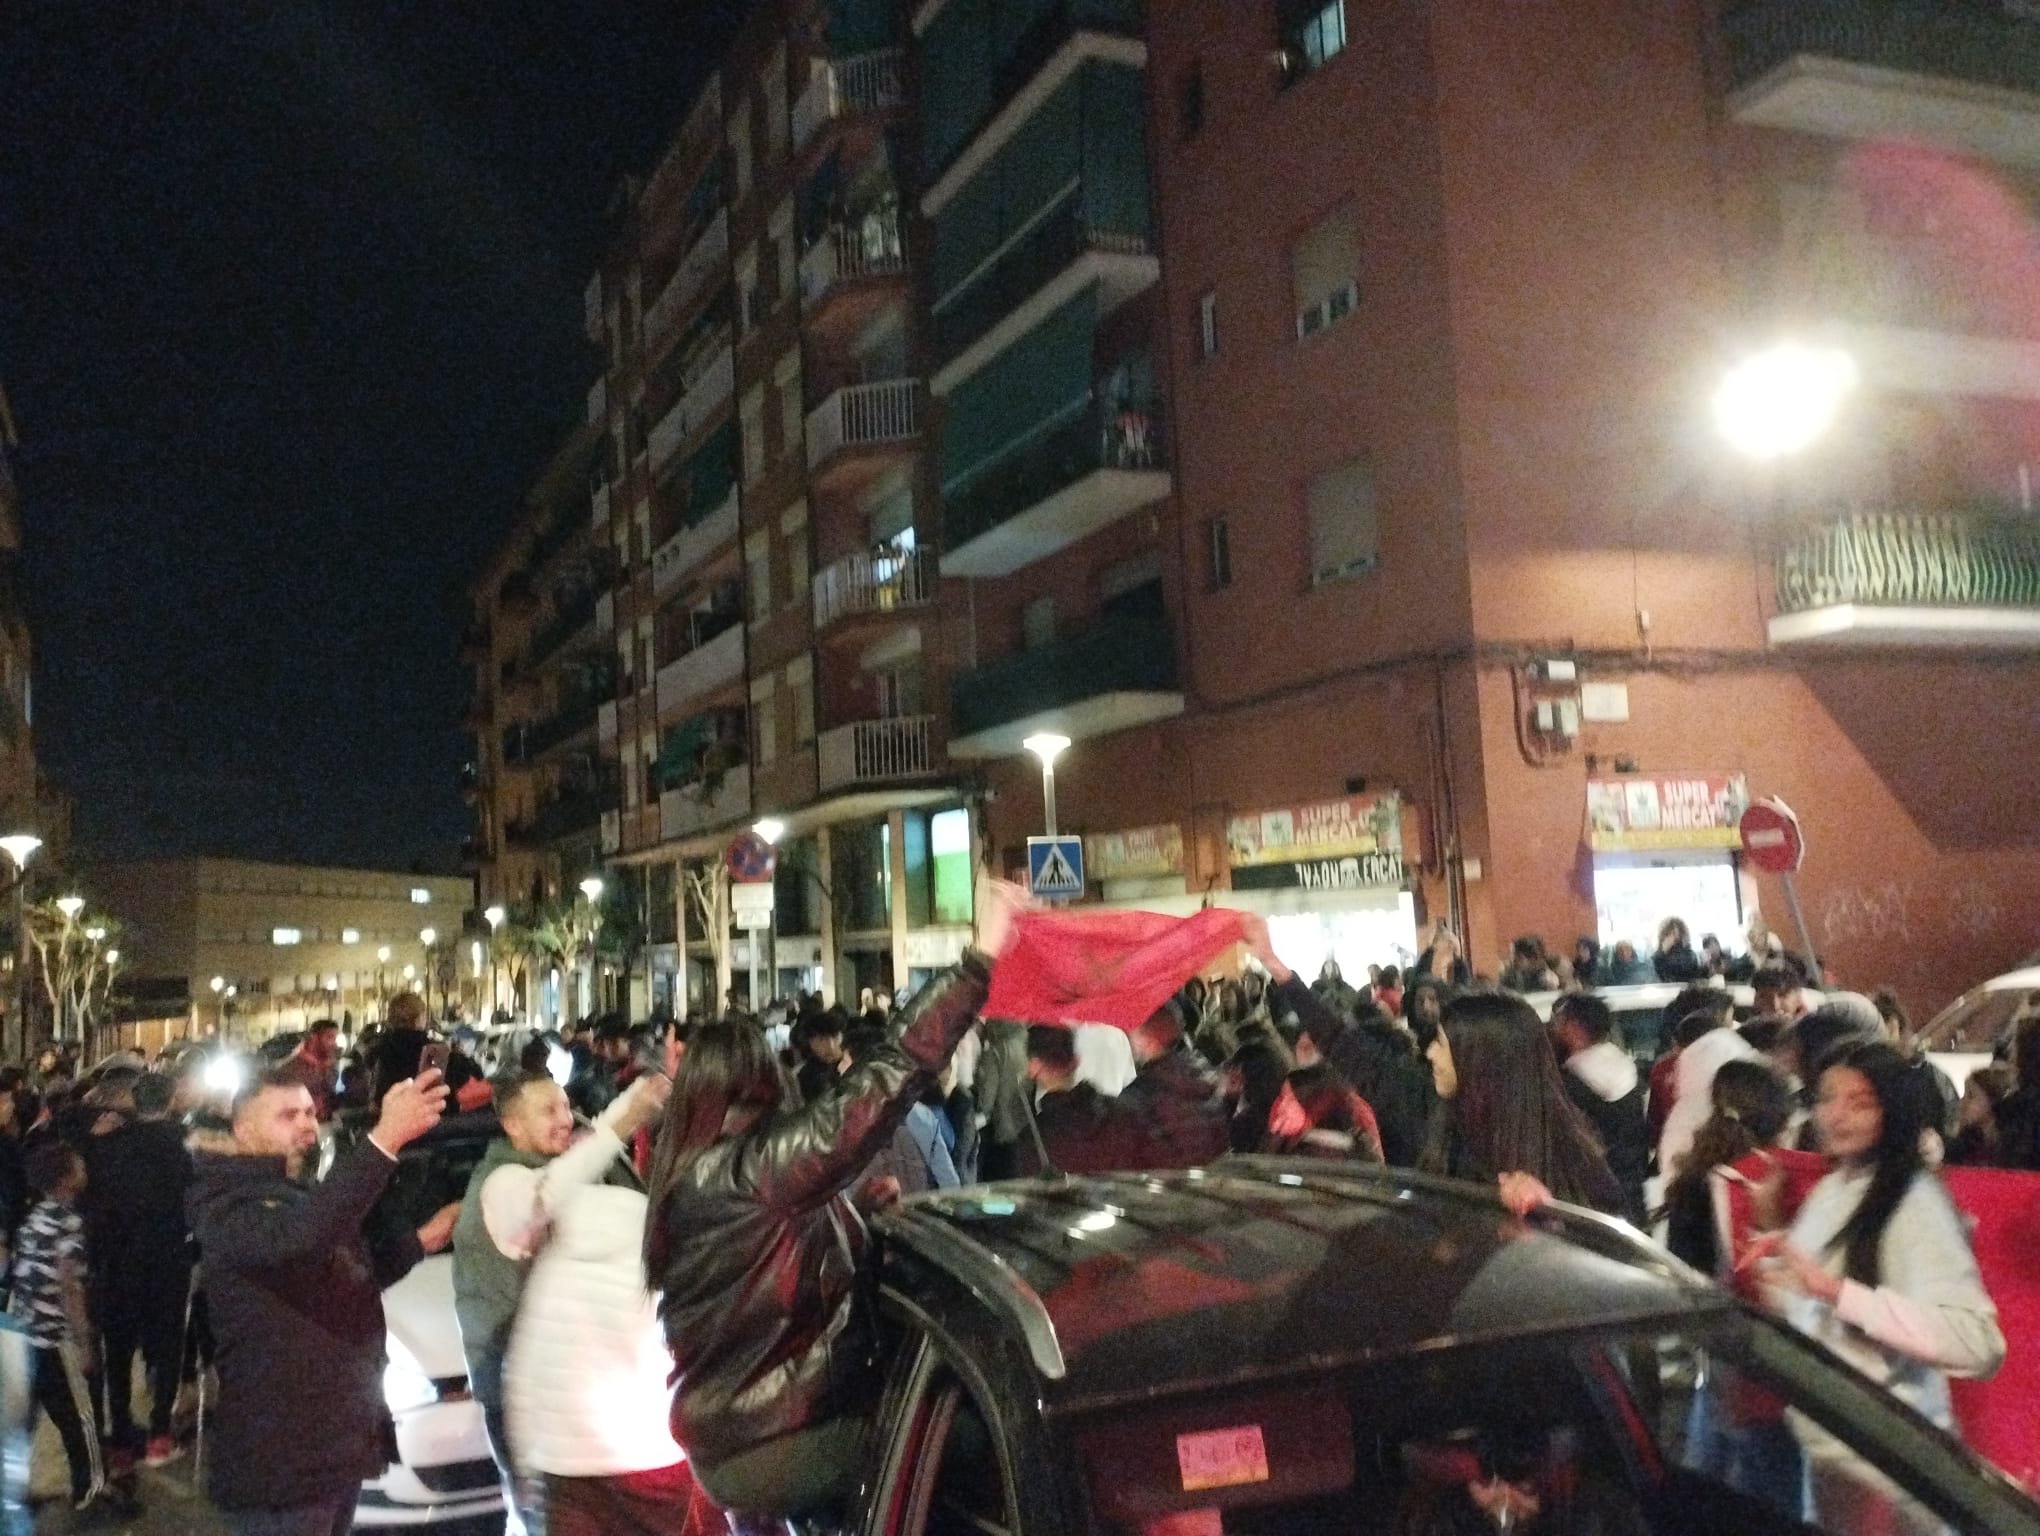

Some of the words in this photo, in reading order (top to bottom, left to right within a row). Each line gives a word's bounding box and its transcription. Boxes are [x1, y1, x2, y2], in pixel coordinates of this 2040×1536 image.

[1300, 801, 1350, 826] SUPER
[1662, 804, 1716, 829] MERCAT
[1296, 819, 1357, 846] MERCAT
